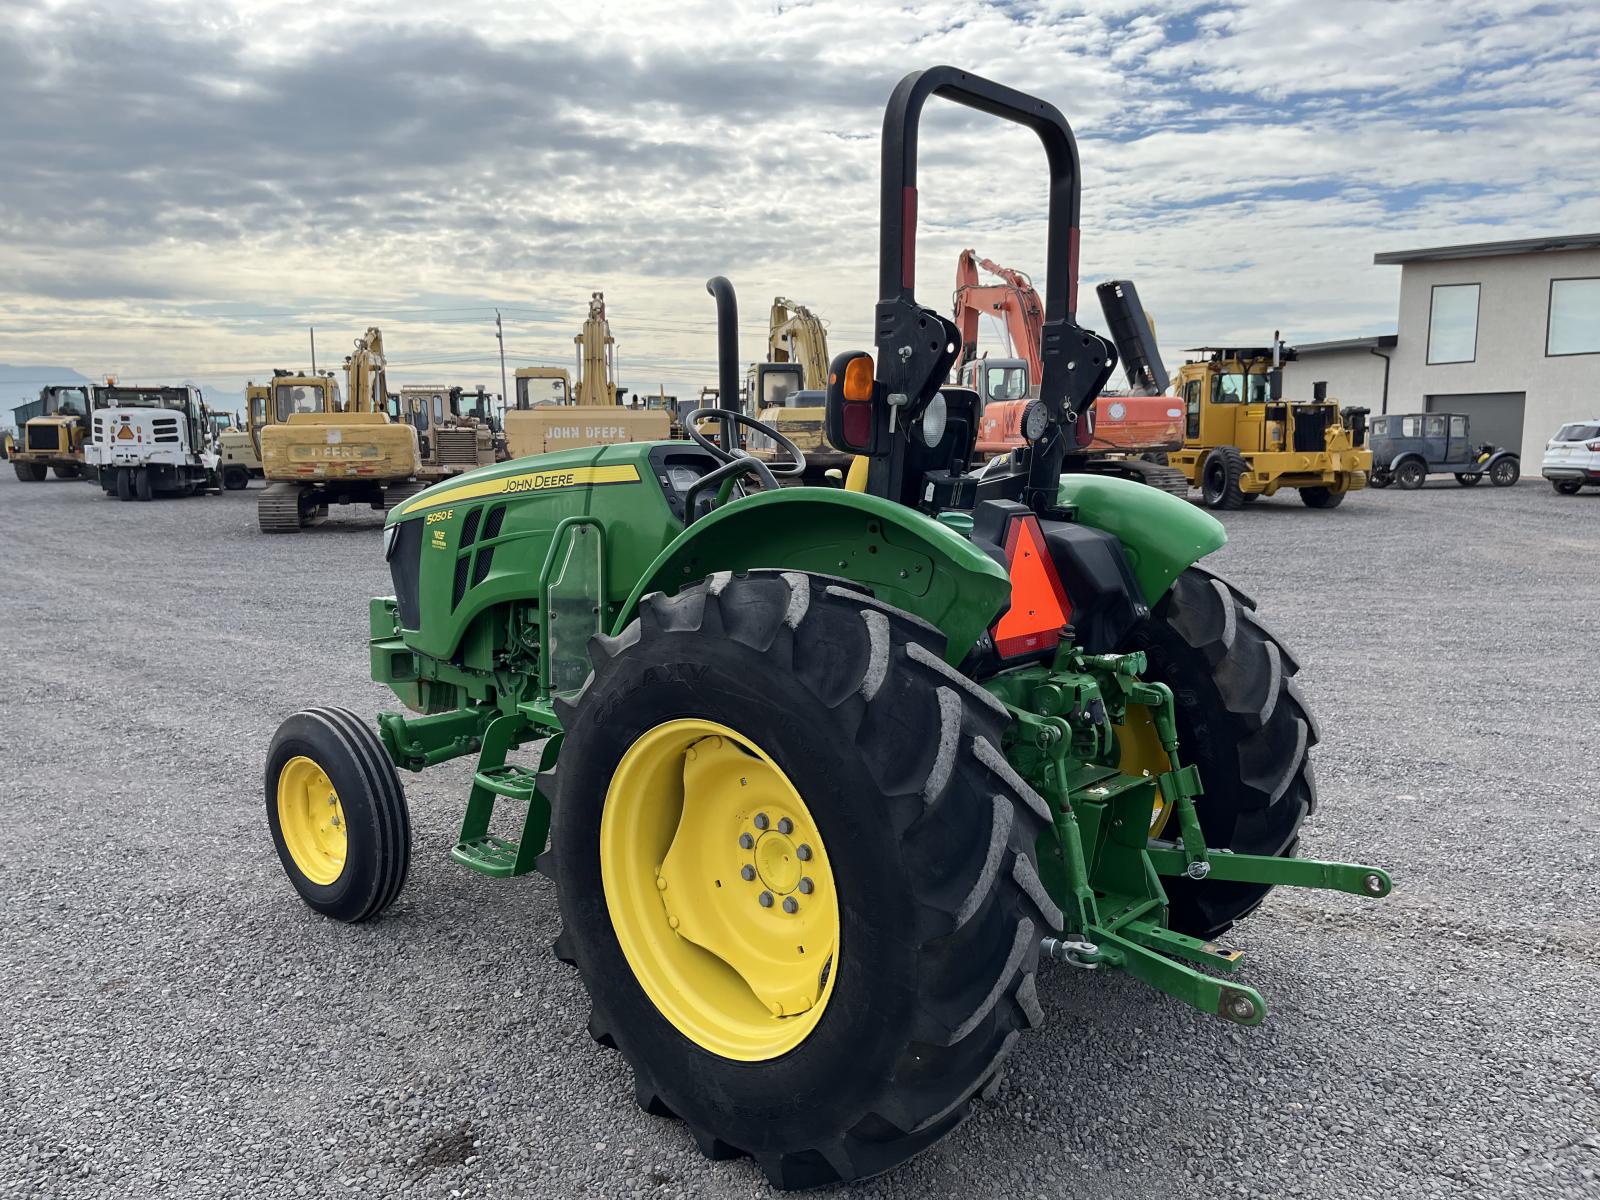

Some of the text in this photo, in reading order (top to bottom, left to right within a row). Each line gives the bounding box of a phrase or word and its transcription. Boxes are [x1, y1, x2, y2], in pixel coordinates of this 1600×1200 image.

[545, 426, 580, 439] JOHN
[502, 473, 575, 492] JOHN DEERE
[426, 511, 447, 525] 5050
